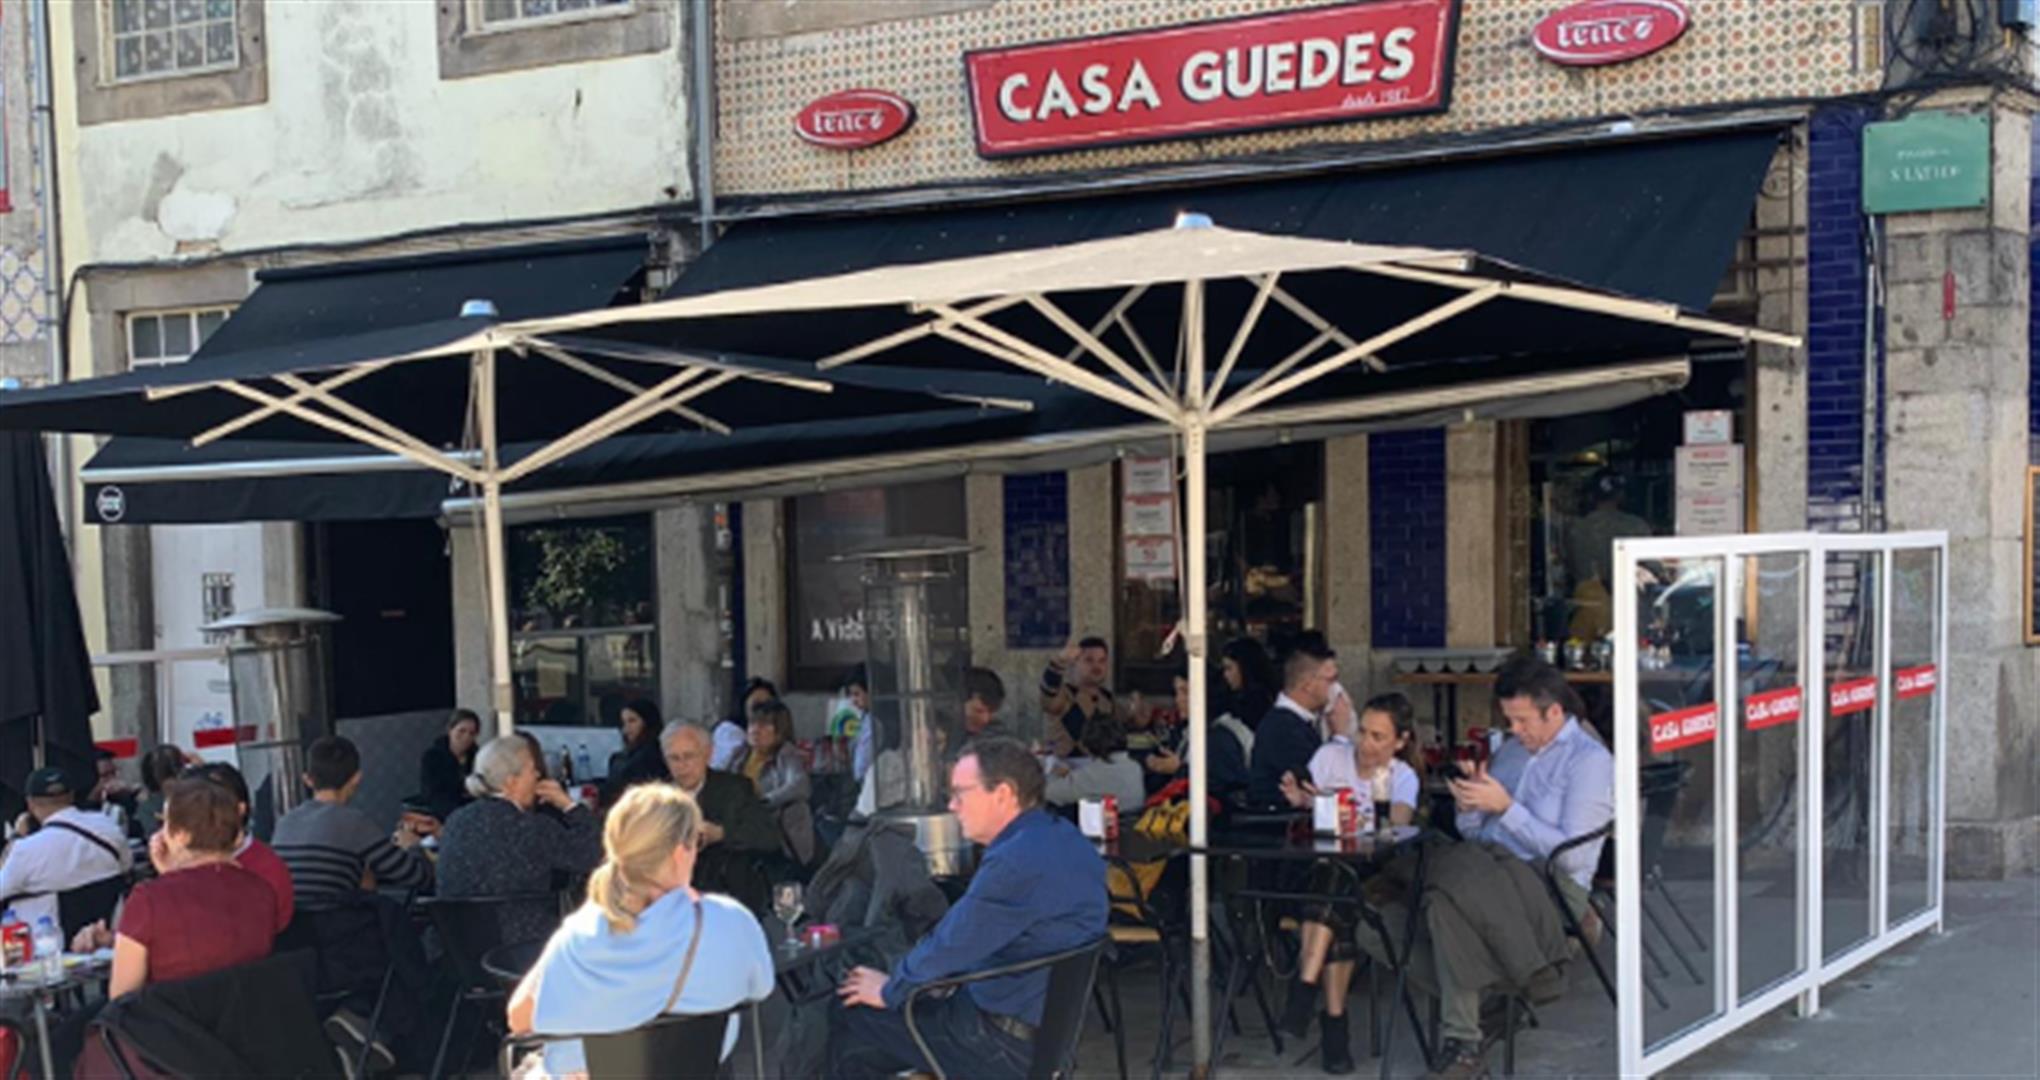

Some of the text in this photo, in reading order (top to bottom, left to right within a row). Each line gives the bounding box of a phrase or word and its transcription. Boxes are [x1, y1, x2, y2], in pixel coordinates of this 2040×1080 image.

[998, 27, 1416, 122] CASA GUEDES
[1652, 720, 1680, 743] CASA
